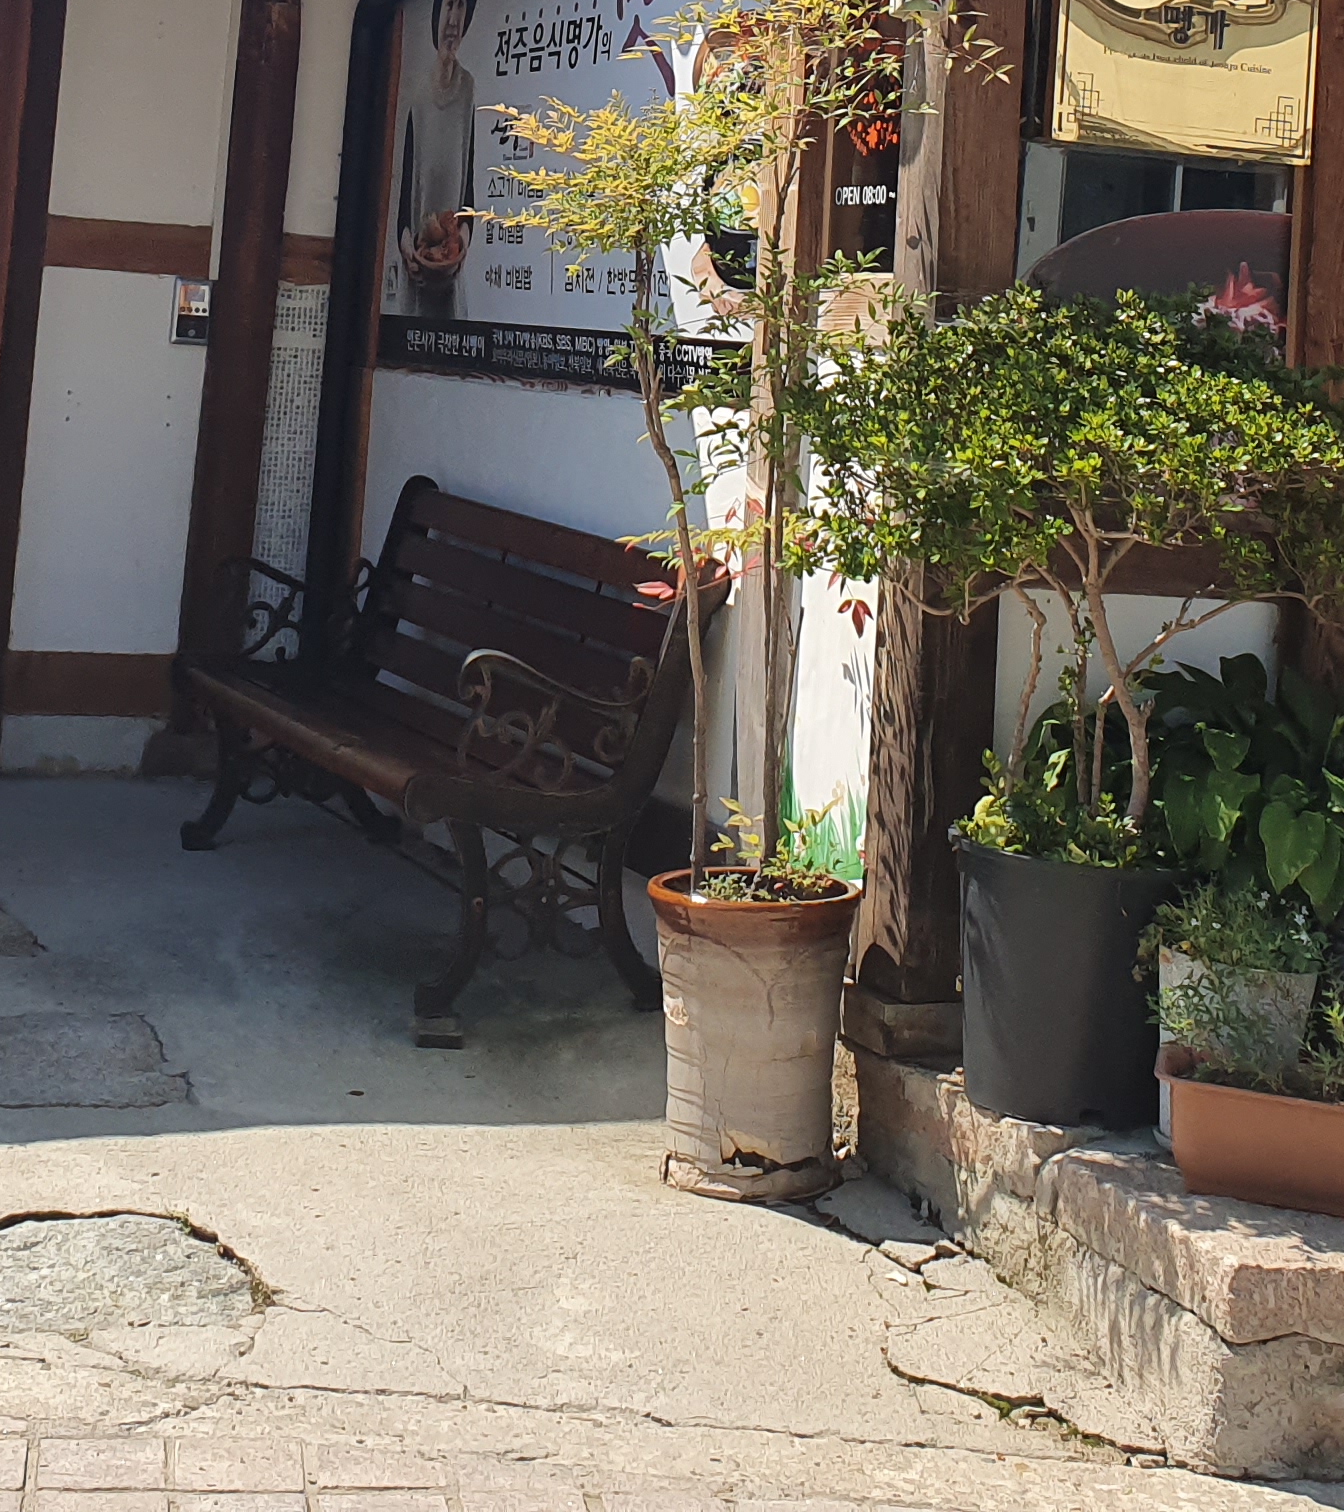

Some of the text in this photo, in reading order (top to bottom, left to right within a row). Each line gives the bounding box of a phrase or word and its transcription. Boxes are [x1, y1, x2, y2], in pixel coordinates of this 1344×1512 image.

[494, 13, 613, 77] 전주음식명가의
[1160, 5, 1231, 50] 명가
[836, 186, 861, 205] OPEN
[862, 185, 887, 205] 08:00
[485, 264, 533, 290] 야채 비빔밥
